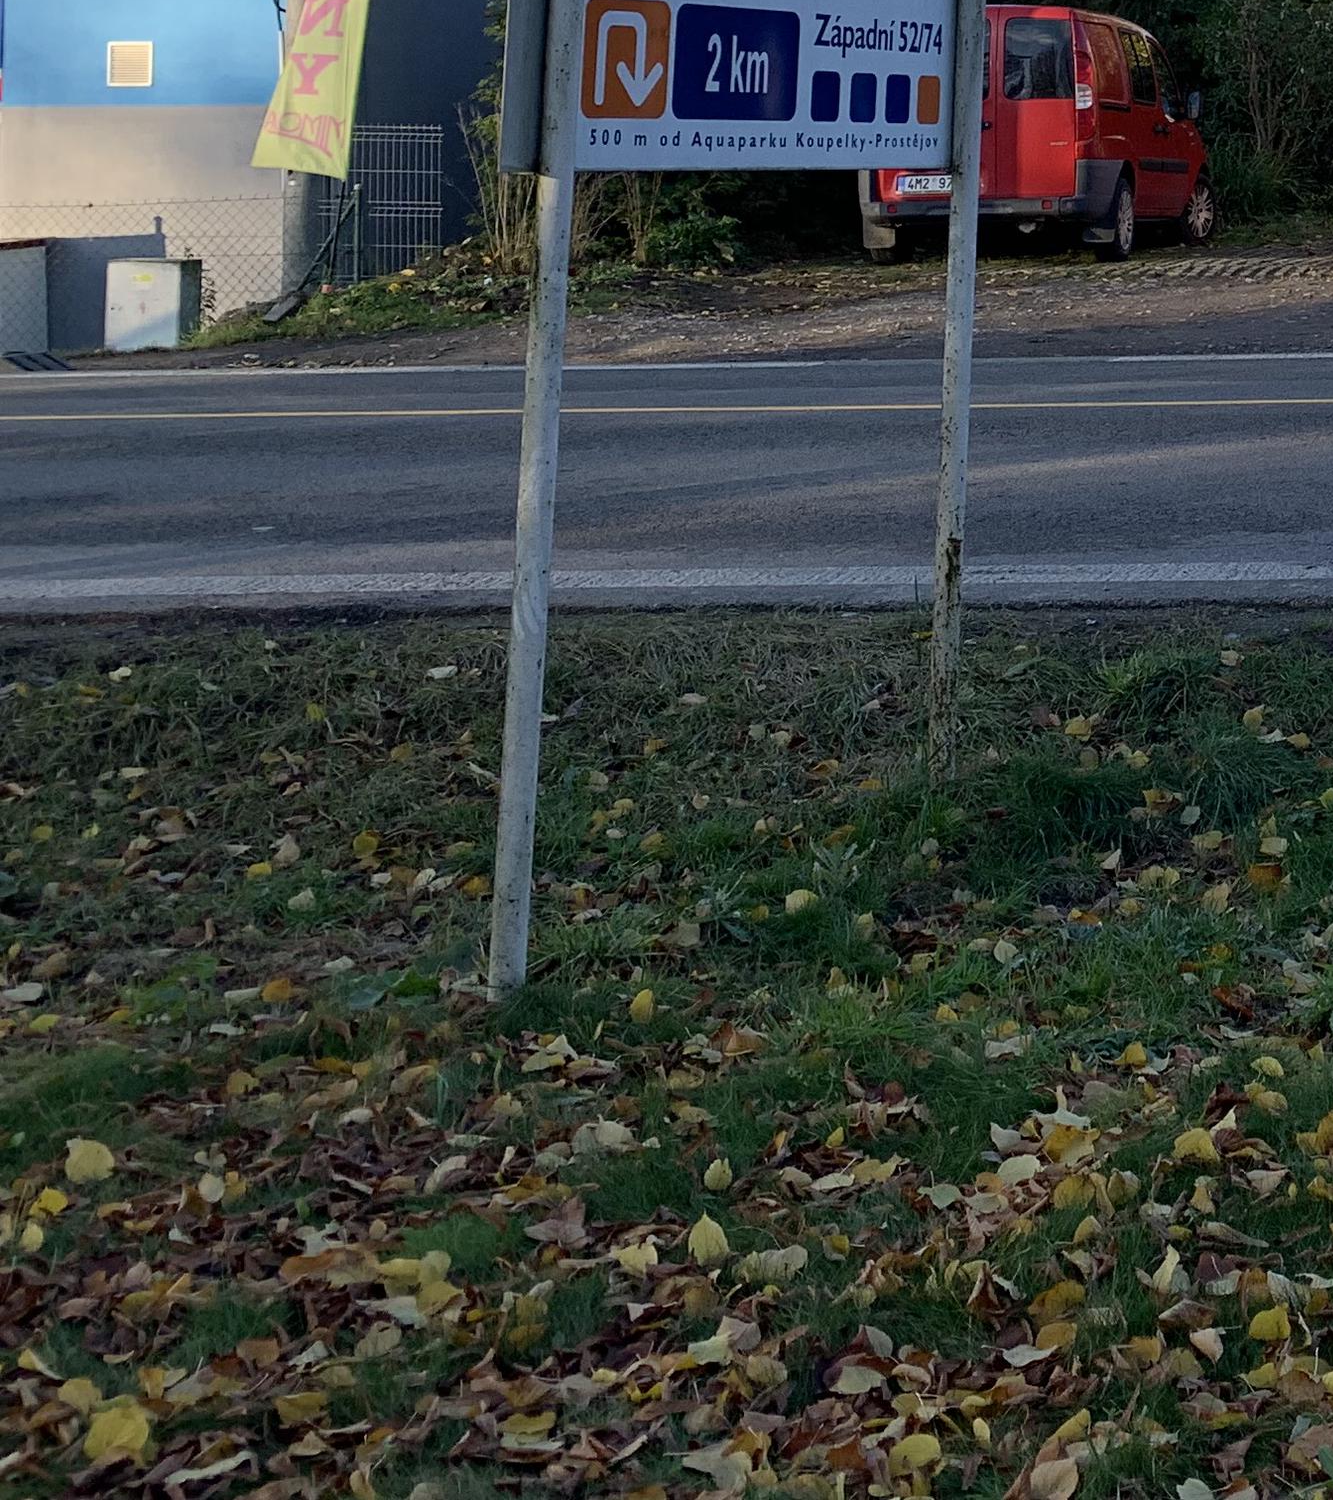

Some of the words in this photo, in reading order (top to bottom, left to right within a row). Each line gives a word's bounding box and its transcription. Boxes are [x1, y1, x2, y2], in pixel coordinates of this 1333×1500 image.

[813, 13, 896, 58] Západní
[898, 21, 944, 55] 52/74
[705, 33, 721, 93] 2
[730, 35, 769, 94] km
[589, 128, 623, 147] 500
[634, 134, 647, 147] m
[660, 131, 682, 147] od
[691, 131, 787, 152] Aquaparku
[908, 178, 930, 189] 4M2
